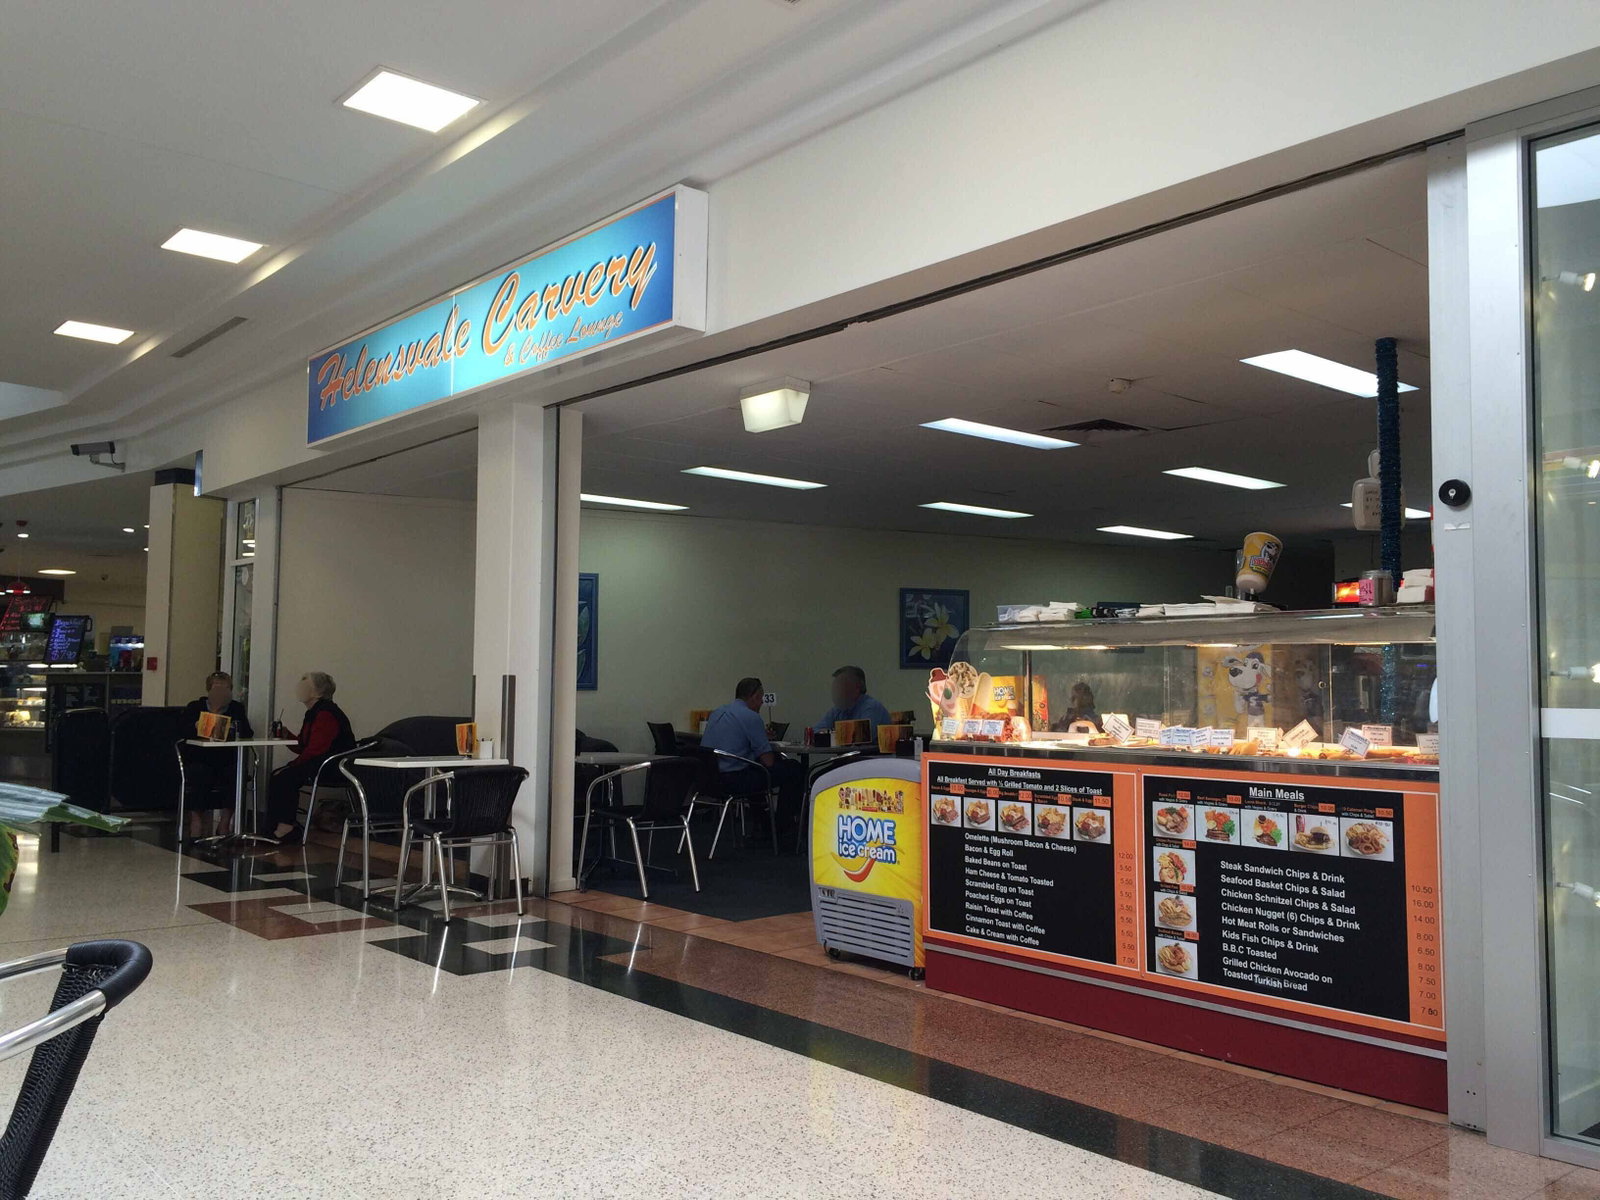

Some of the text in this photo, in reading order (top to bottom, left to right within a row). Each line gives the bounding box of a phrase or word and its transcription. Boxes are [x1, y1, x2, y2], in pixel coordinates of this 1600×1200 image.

[317, 242, 658, 411] Helensvale Carvery
[504, 312, 624, 366] & Coffee Lounge
[764, 694, 775, 704] 33
[988, 768, 1041, 778] All Day Breakfasts
[1249, 786, 1304, 800] Main Meals
[838, 815, 896, 845] HOME
[838, 839, 896, 863] ice cream
[965, 833, 989, 842] Omelette
[991, 836, 1023, 847] (Mushroom
[1024, 840, 1043, 848] Bacon
[1051, 843, 1077, 854] Cheese)
[965, 844, 982, 853] Bacon
[989, 847, 1000, 857] Egg
[965, 856, 982, 864] Baked
[983, 858, 1000, 867] Beans
[1011, 862, 1027, 870] Toast
[1220, 861, 1345, 883] Steak Sandwich Chips & Drink
[965, 879, 994, 890] Scrambled
[996, 884, 1007, 893] Egg
[1018, 887, 1034, 896] Toast
[979, 869, 1000, 879] Cheese
[1007, 873, 1028, 883] Tomato
[1030, 876, 1054, 886] Toasted
[1220, 875, 1345, 898] Seafood Basket Chips & Salad
[965, 890, 989, 901] Poached
[990, 895, 1005, 904] Eggs
[1015, 899, 1032, 908] Toast
[1221, 889, 1356, 914] Chicken Schnitzel Chips & Salad
[965, 902, 982, 912] Raisin
[984, 906, 999, 914] Toast
[1014, 911, 1033, 920] Coffee
[1221, 902, 1360, 930] Chicken Nugget (6) Chips & Drink
[965, 914, 993, 925] Cinnamon
[995, 919, 1011, 928] Toast
[1026, 924, 1045, 934] Coffee
[1222, 916, 1236, 925] Hot
[1238, 918, 1256, 929] Meat
[1258, 921, 1280, 932] Rolls
[1292, 926, 1345, 942] Sandwiches
[966, 926, 979, 934] Cake
[986, 928, 1005, 938] Cream
[1020, 935, 1039, 946] Coffee
[1222, 930, 1319, 953] Kids Fish Chips & Drink
[1222, 943, 1277, 959] B.B.C Toasted
[1223, 957, 1248, 968] Grilled
[1250, 962, 1281, 974] Chicken
[1283, 968, 1319, 982] Avocado
[1223, 968, 1308, 991] Toasted Turkish Bread
